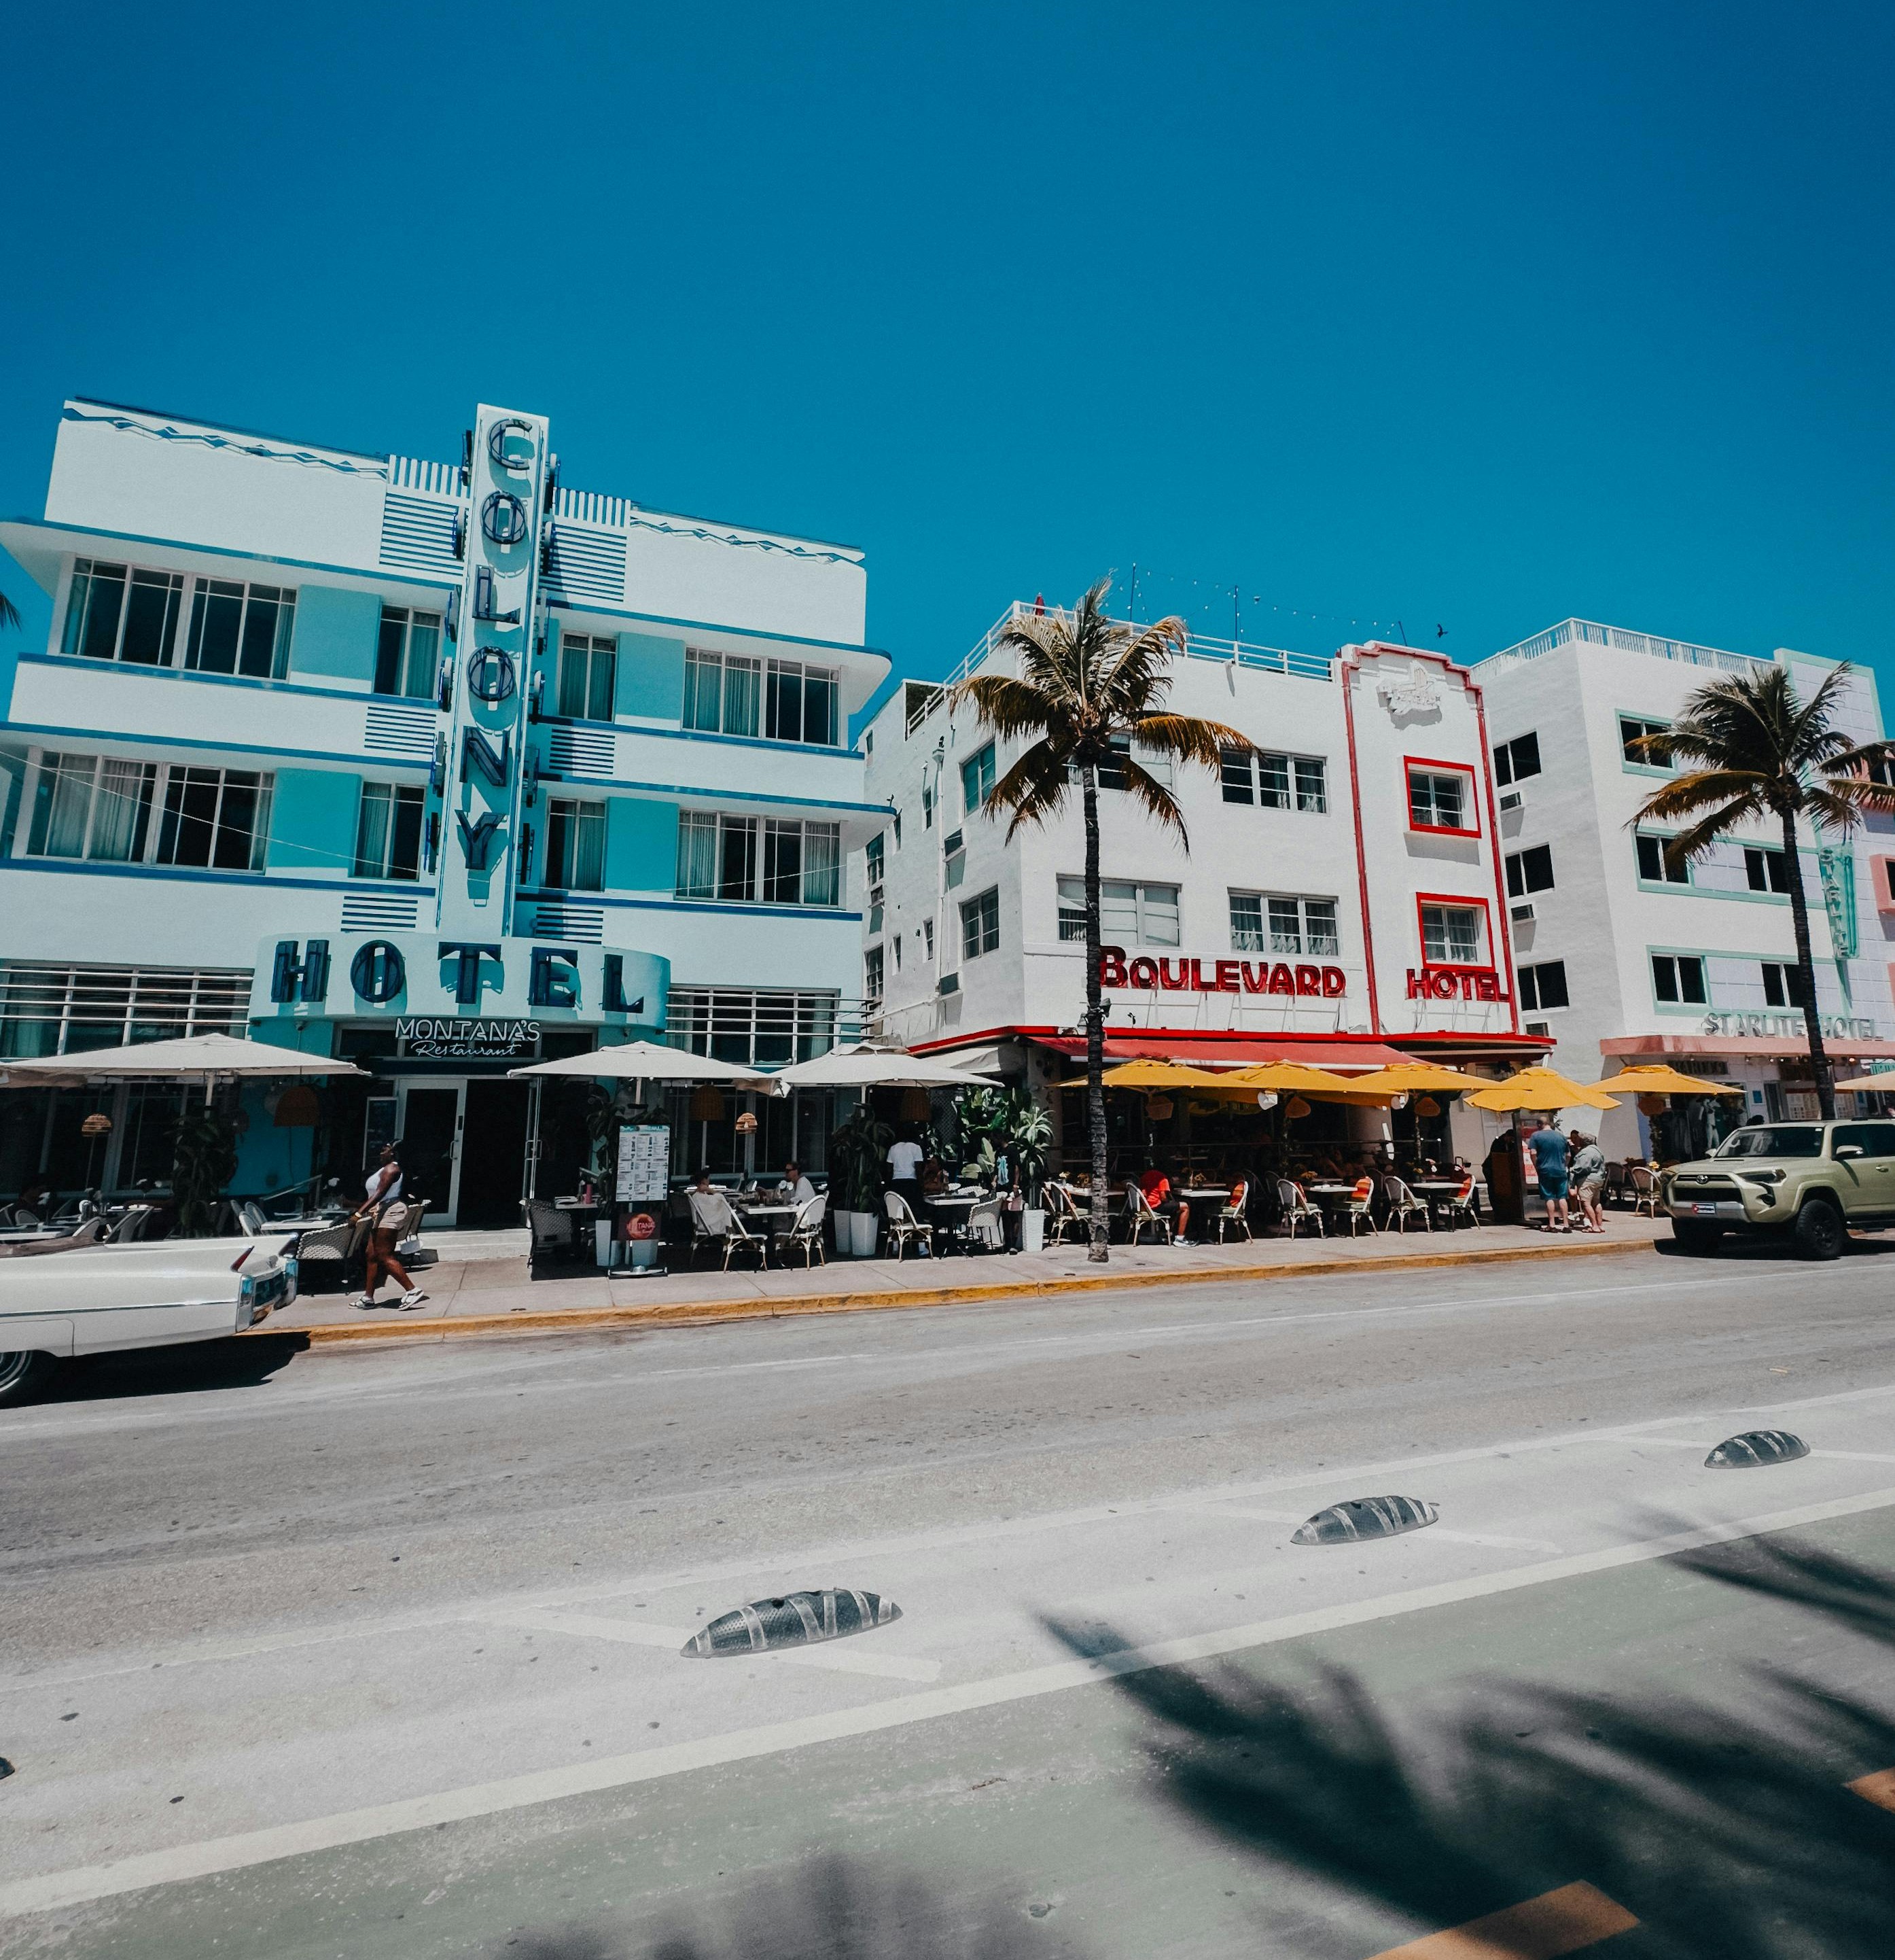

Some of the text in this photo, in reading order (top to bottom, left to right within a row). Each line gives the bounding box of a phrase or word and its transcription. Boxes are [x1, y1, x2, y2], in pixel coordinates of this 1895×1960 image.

[455, 418, 533, 871] COLONY
[271, 939, 644, 1013] HOTEL
[1099, 945, 1510, 1002] BOULEVARD HOTEL
[395, 1017, 541, 1042] MONTANA'S
[1701, 1013, 1884, 1042] STARLITE HOTEL
[410, 1040, 522, 1059] Restaurant
